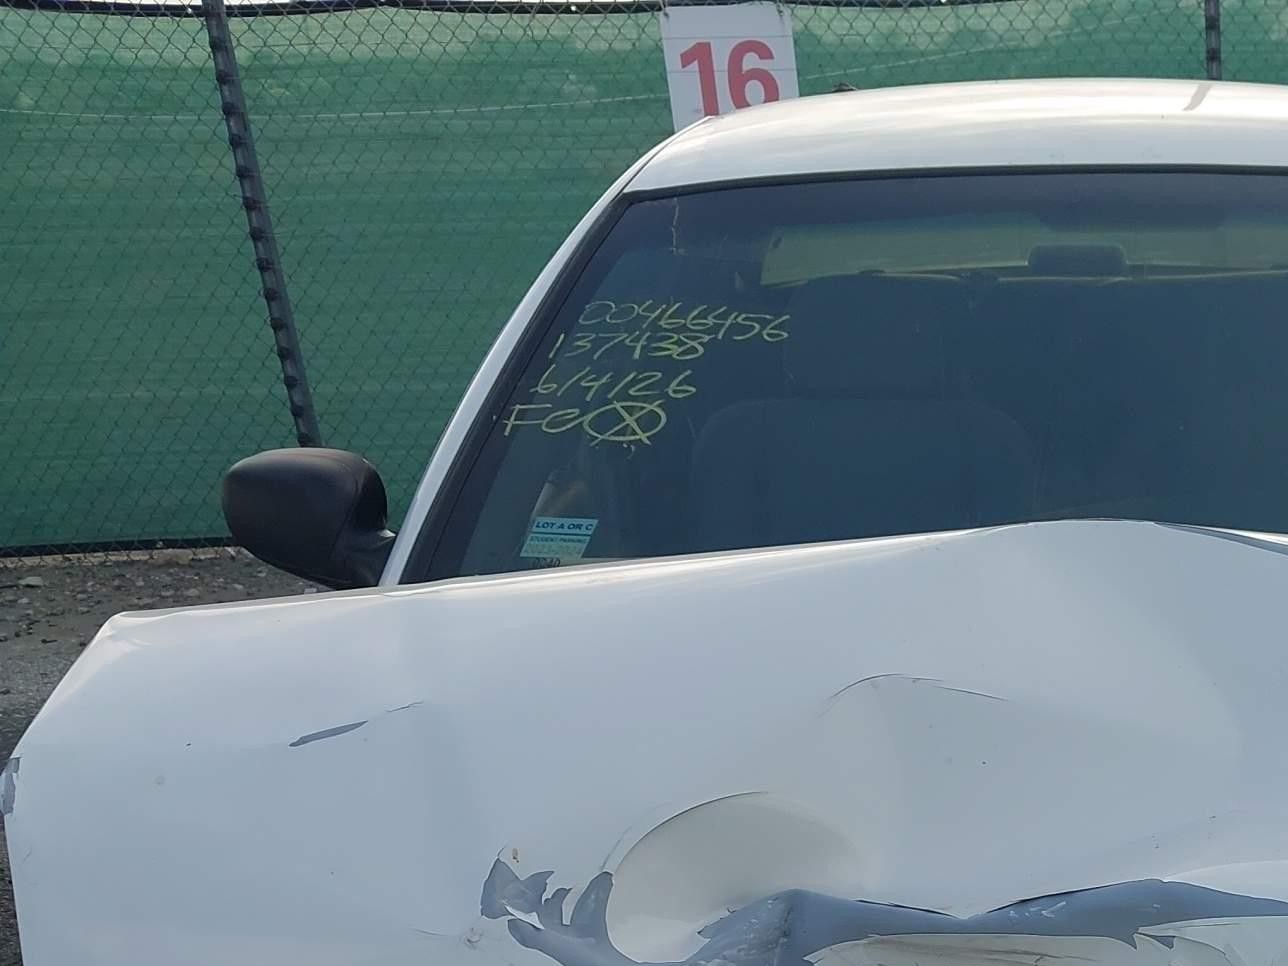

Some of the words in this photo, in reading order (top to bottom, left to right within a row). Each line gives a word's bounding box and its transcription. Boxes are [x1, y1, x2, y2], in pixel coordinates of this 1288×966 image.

[680, 40, 779, 115] 16
[579, 300, 790, 341] 00466456
[549, 331, 714, 359] 137438
[530, 364, 696, 401] 6/4/26
[535, 521, 556, 529] LOT
[585, 523, 594, 531] C
